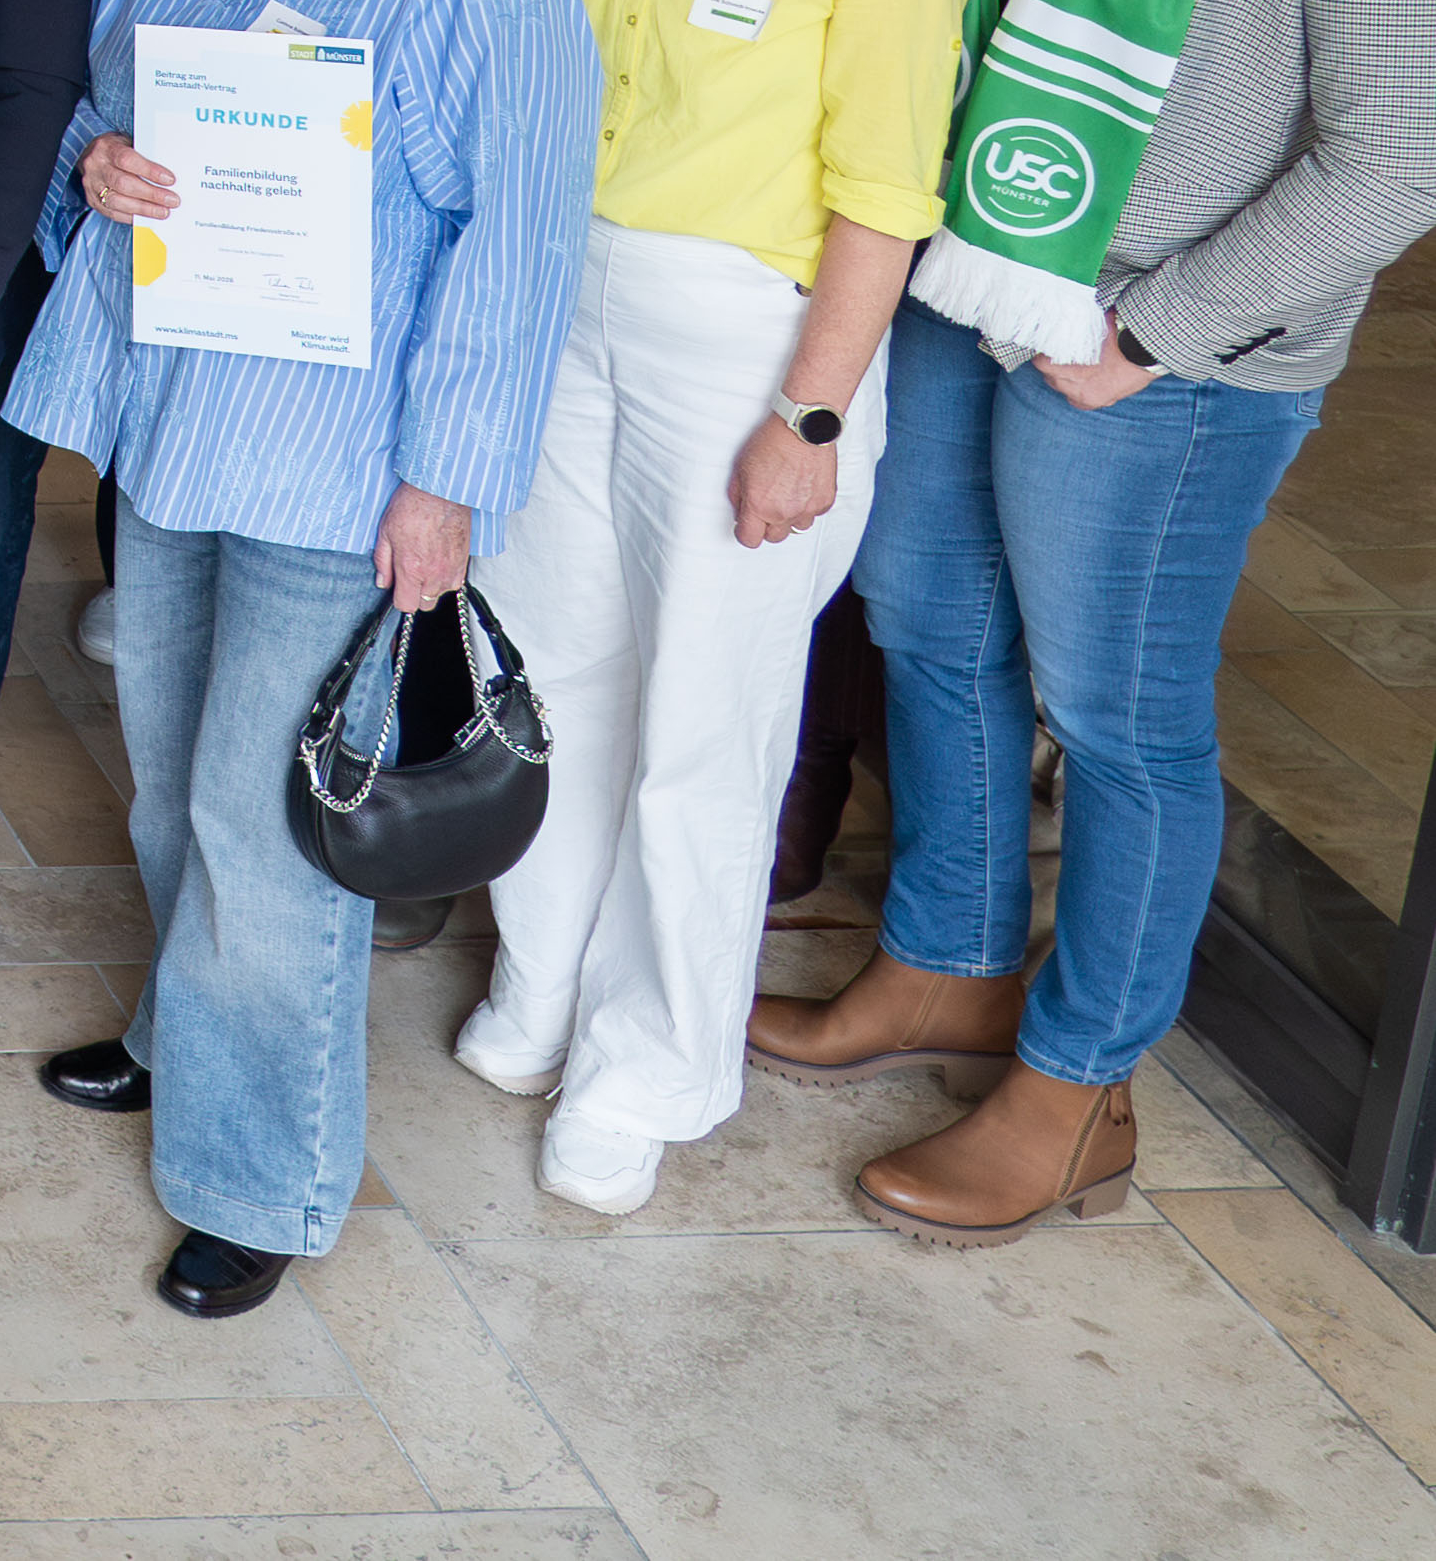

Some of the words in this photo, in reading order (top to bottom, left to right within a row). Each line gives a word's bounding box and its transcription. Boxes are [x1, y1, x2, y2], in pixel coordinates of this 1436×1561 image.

[326, 53, 362, 62] MÜNSTER
[155, 70, 186, 81] Beitrag
[155, 79, 237, 94] Klimastadt-Vertrag
[196, 107, 309, 131] URKUNDE
[204, 166, 298, 184] Familienbildung
[985, 142, 1079, 199] USC
[201, 180, 262, 195] nachhaltig
[265, 185, 302, 198] gelebt
[990, 184, 1050, 208] MÜNSTER
[155, 325, 238, 340] www.klimastadt.ms
[291, 331, 327, 342] Münster
[330, 335, 349, 344] wird
